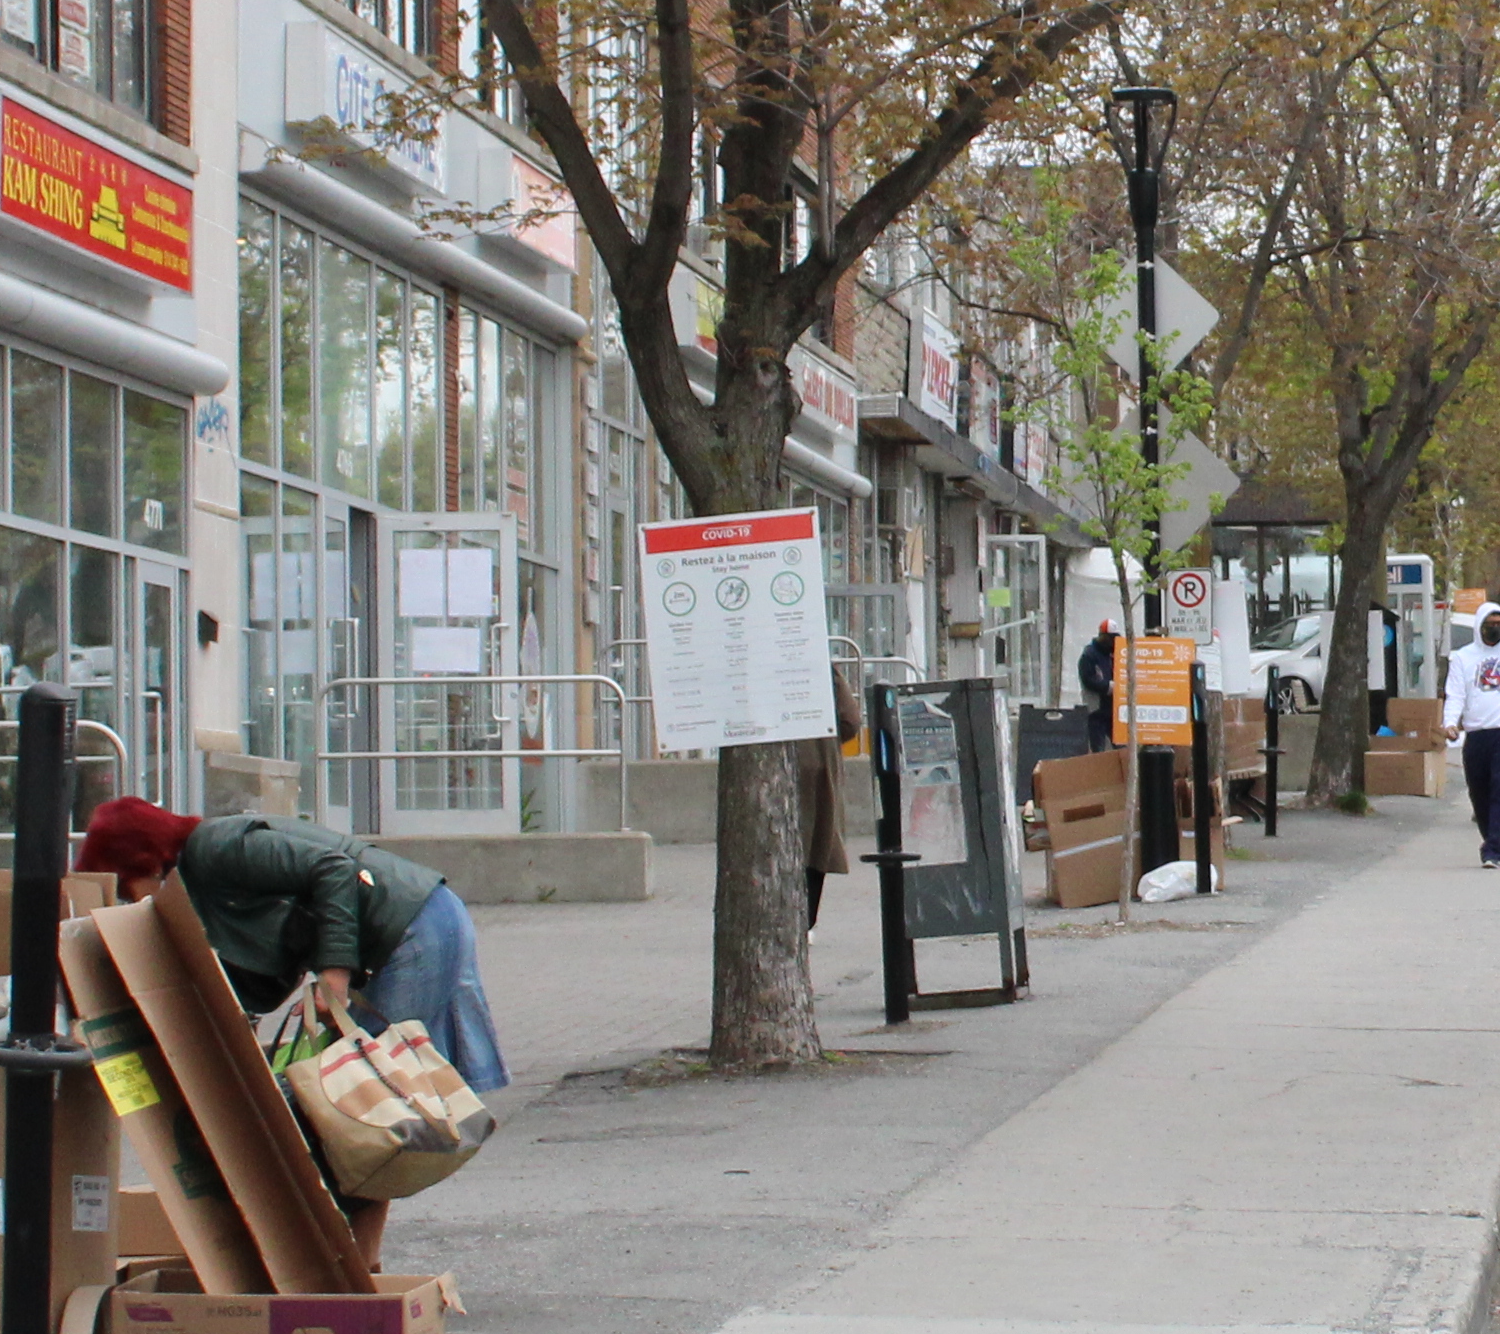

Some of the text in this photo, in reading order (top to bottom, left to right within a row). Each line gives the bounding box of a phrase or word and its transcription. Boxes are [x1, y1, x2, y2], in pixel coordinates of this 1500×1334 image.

[3, 113, 84, 182] RESTAURANT
[2, 153, 38, 209] KAM
[39, 171, 84, 231] SHING
[701, 525, 750, 542] COVID-19
[681, 550, 777, 568] Restez à la maison
